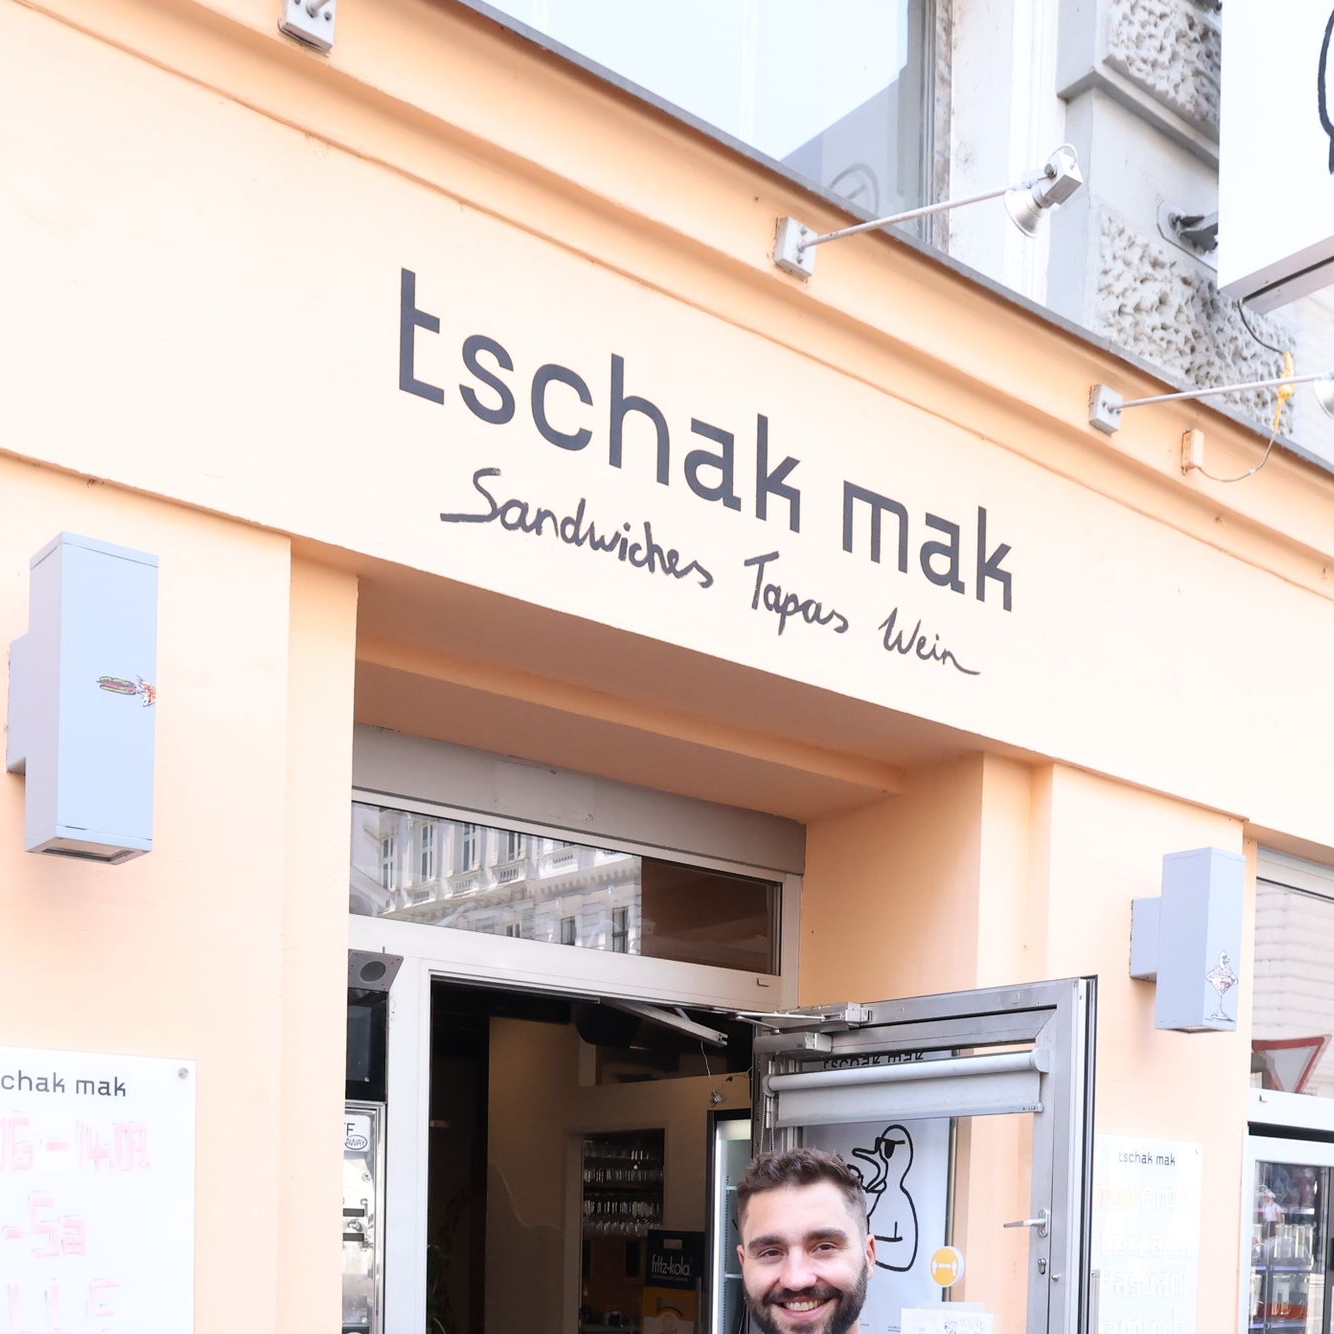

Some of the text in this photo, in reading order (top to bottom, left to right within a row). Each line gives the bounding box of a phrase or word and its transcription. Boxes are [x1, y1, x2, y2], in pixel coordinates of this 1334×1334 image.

[398, 266, 1013, 613] tschak mak
[439, 467, 980, 677] Sandwiches Tapas Wein
[74, 1076, 127, 1098] mak
[1118, 1149, 1176, 1166] tschak mak
